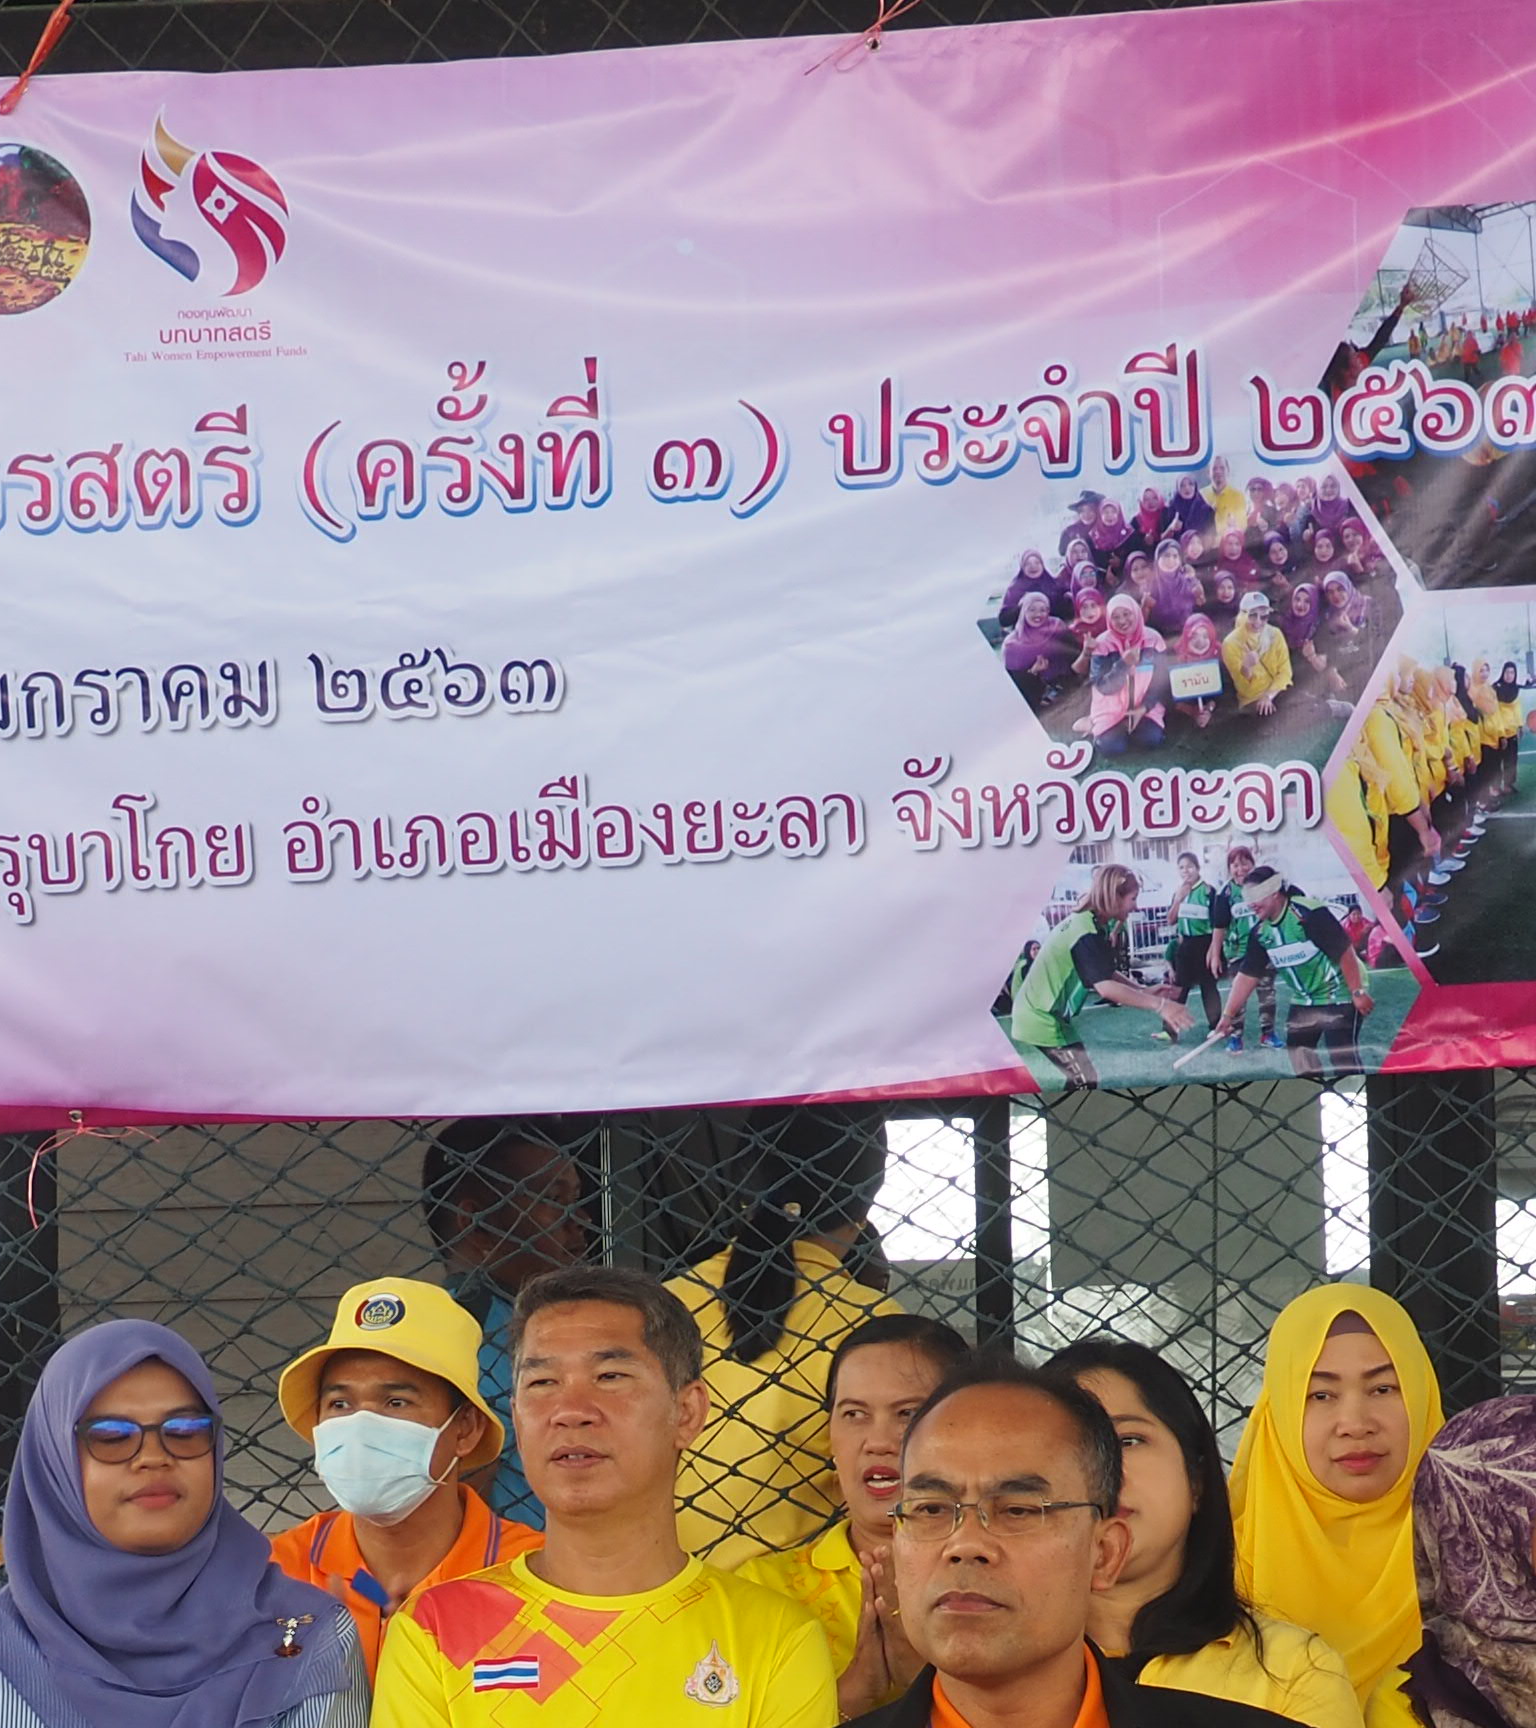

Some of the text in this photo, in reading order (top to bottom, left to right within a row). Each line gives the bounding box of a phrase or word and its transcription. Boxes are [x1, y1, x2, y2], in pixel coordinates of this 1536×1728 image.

[152, 350, 193, 361] Women
[196, 348, 272, 361] Empowerment
[276, 345, 308, 357] Funds
[159, 320, 272, 344] บทบาทสตรี
[302, 354, 602, 532] (ครั้งที่
[651, 398, 782, 509] ๓)
[828, 343, 1200, 480] ประจำปี
[309, 648, 559, 712] ๒๕๖๓
[284, 774, 857, 875] อำเภอเมืองยะลา
[893, 741, 1322, 844] จังหวัดยะลา
